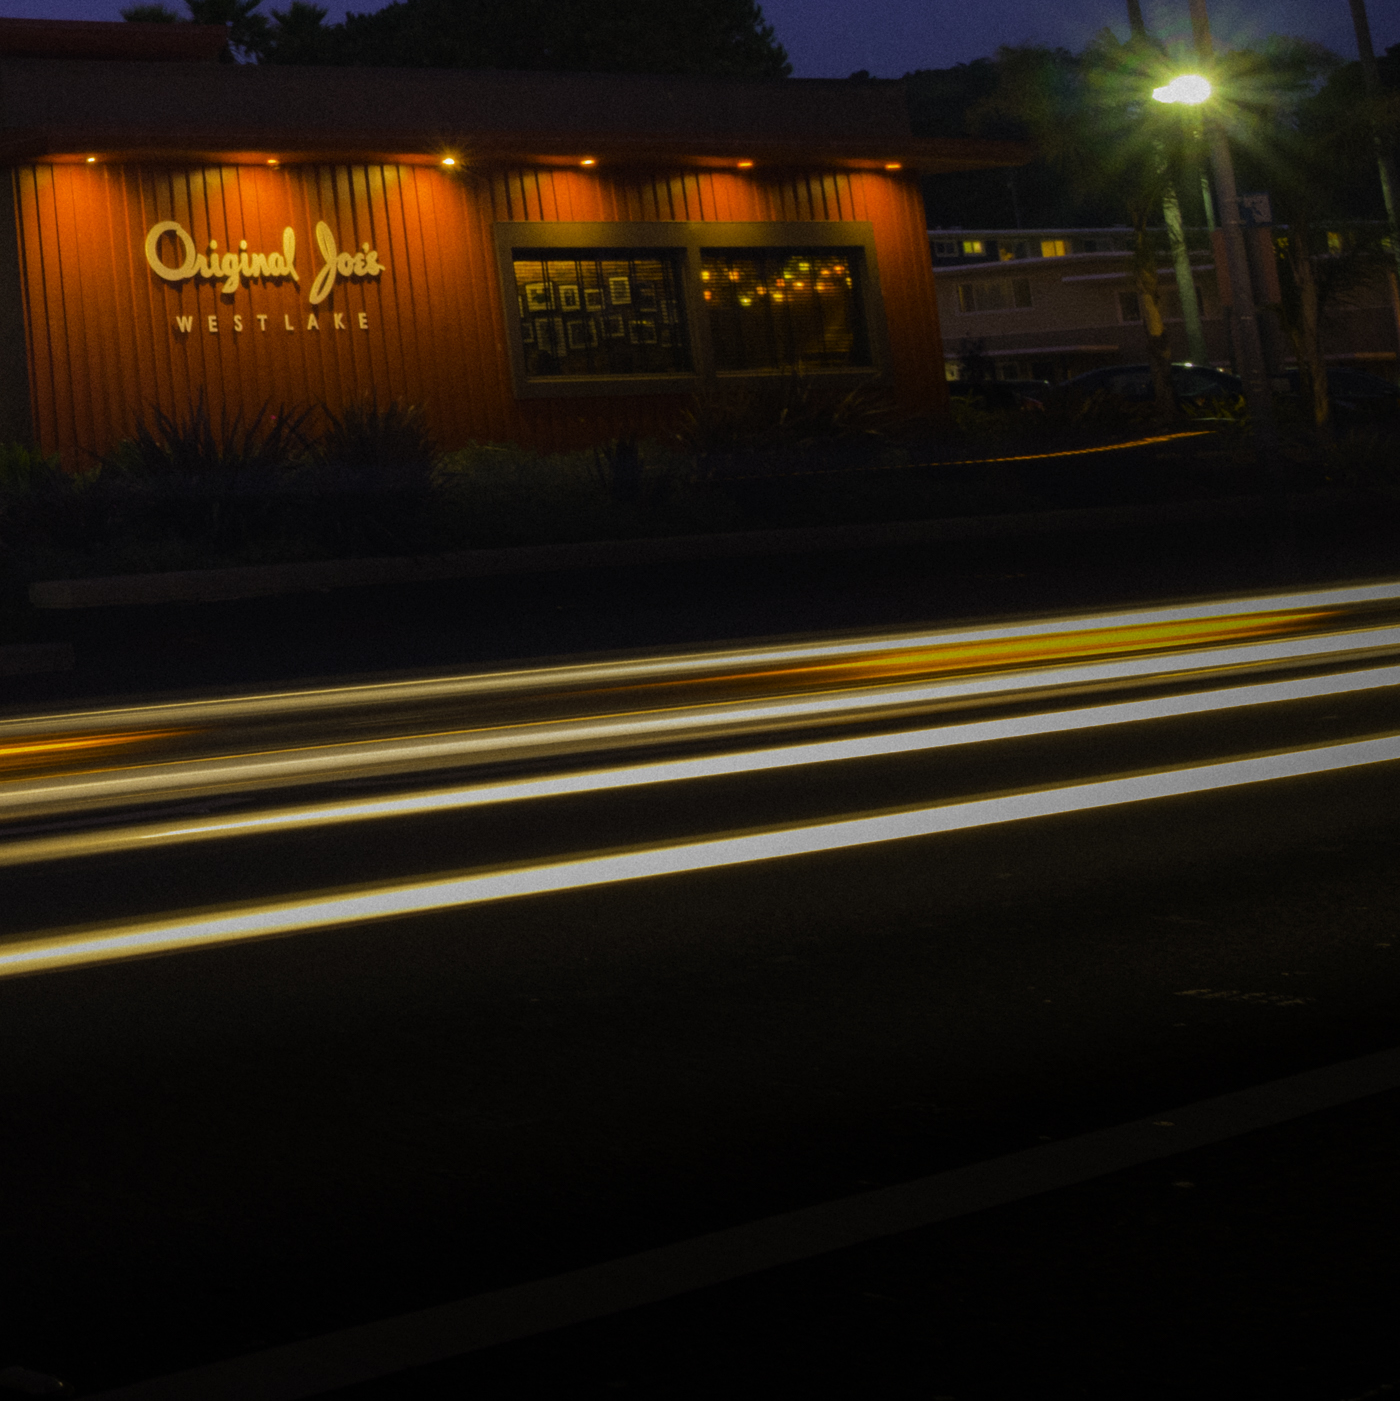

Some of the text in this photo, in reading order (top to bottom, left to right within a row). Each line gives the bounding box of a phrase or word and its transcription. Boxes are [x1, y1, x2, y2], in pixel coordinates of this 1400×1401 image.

[145, 220, 386, 305] Original Joe's
[176, 312, 369, 333] WESTLAKE
